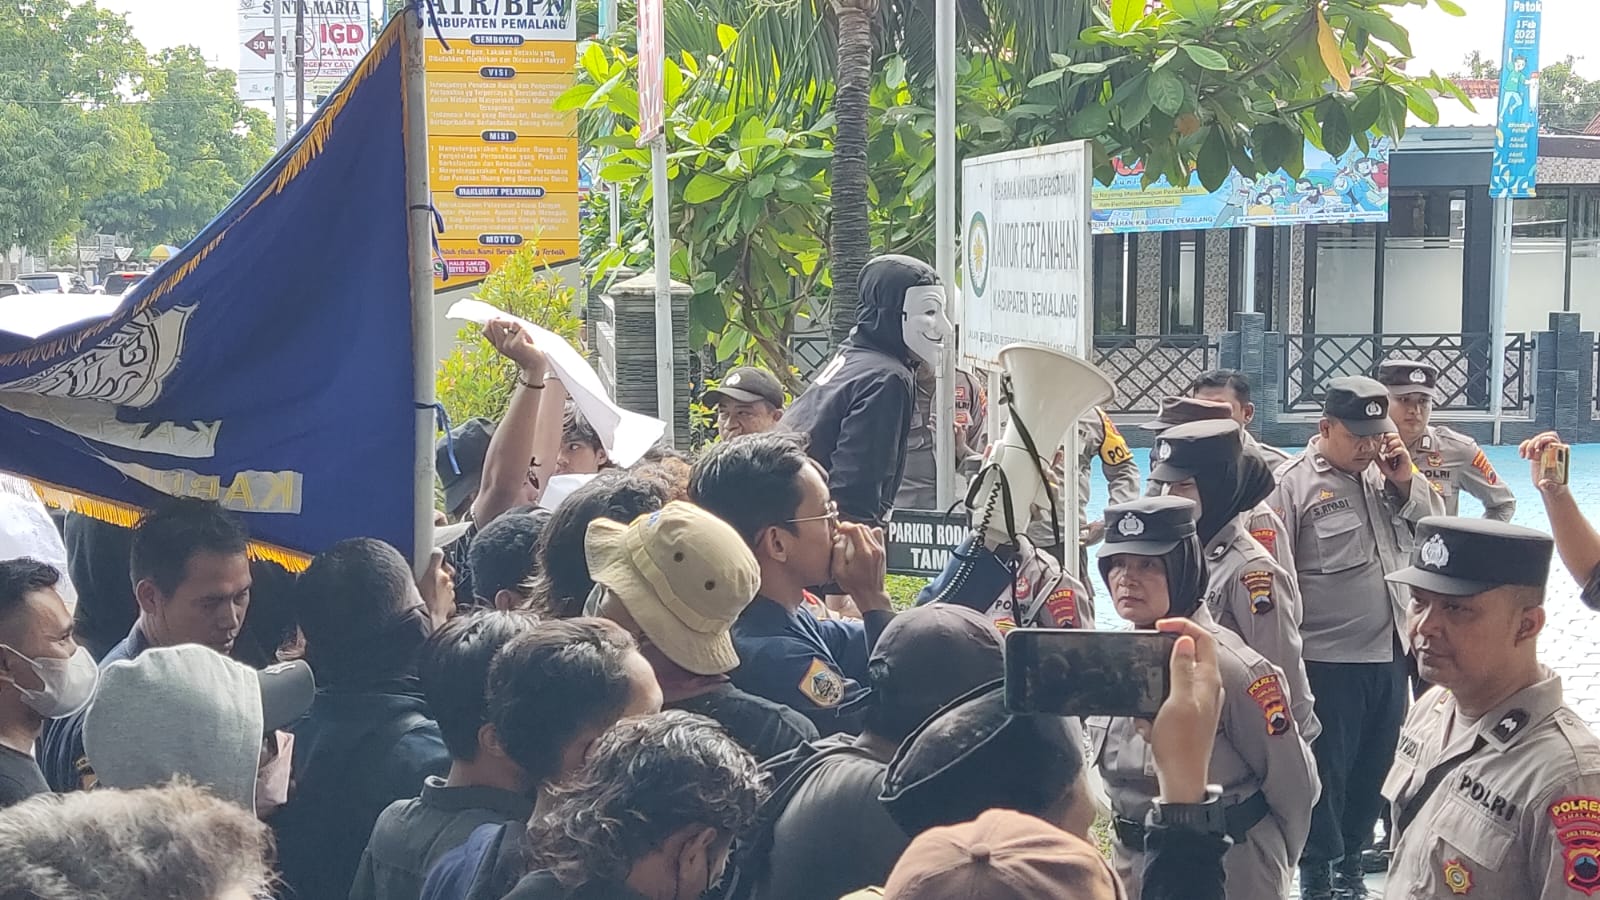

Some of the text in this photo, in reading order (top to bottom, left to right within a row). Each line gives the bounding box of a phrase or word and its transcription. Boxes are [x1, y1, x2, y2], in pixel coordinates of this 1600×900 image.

[262, 0, 360, 15] SNTA MARIA
[1513, 1, 1542, 13] Patok
[428, 18, 567, 30] KABUPATEN PEMALANG
[1521, 20, 1536, 29] Feb
[320, 23, 364, 44] IGD
[1514, 29, 1536, 39] 2023
[253, 40, 266, 50] 50
[475, 36, 520, 44] SEMBOYAN
[321, 47, 358, 56] 24 JAM
[488, 69, 508, 77] VISI
[489, 132, 510, 141] MISI
[1038, 172, 1077, 197] PERSATUAN
[458, 188, 541, 196] MAKLUMAT PELAYANAN
[1135, 217, 1175, 226] KABUPATEN
[1176, 216, 1214, 224] PEMALANG
[485, 235, 516, 244] MOTTO
[992, 218, 1079, 271] KANTOR PERTANAHAN
[993, 290, 1078, 319] KABUPATEN PEMALANG
[888, 521, 970, 547] PARKIR RODA
[1248, 676, 1276, 696] POLRES
[1459, 774, 1518, 822] POLRI
[1551, 799, 1600, 817] POLRE
